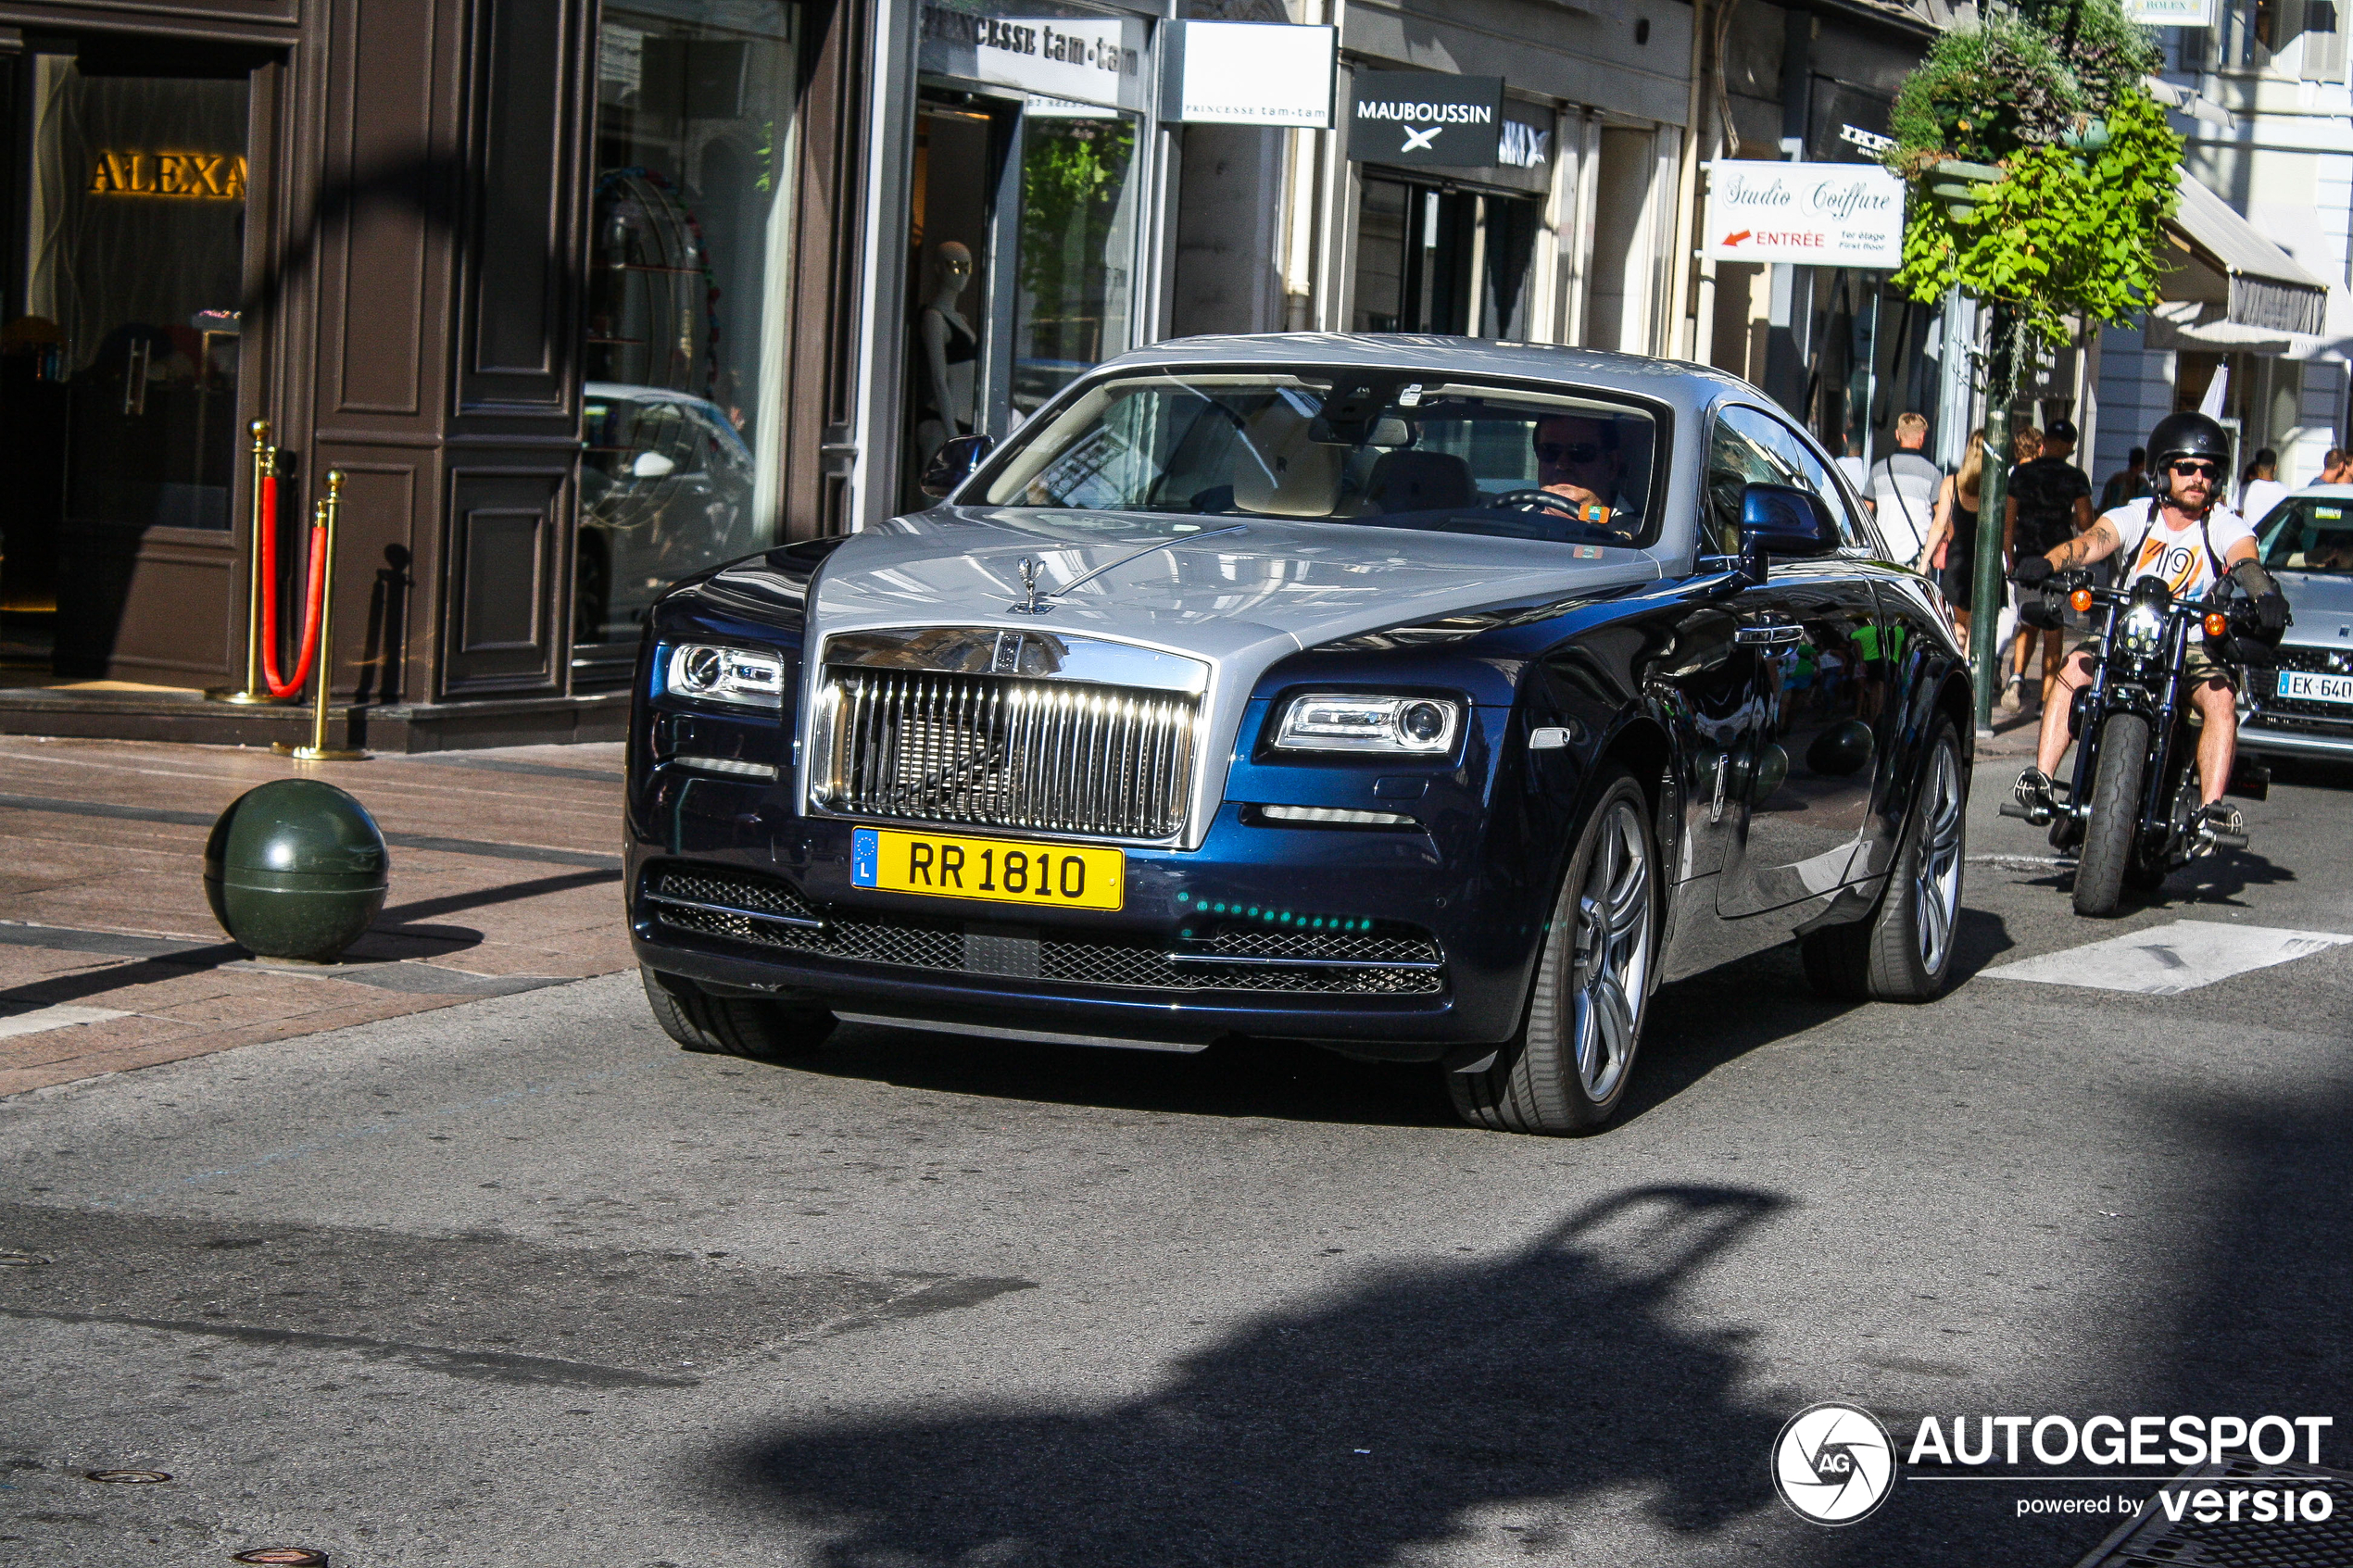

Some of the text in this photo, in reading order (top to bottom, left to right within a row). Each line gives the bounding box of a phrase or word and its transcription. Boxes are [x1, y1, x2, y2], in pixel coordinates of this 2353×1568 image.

[1186, 104, 1255, 115] PRINCESSE
[1357, 100, 1491, 123] MAUBOUSSIN
[1723, 174, 1890, 221] Studio Coiffure
[1756, 230, 1825, 247] ENTRÉE
[860, 862, 870, 878] L
[909, 841, 1086, 898] RR 1810
